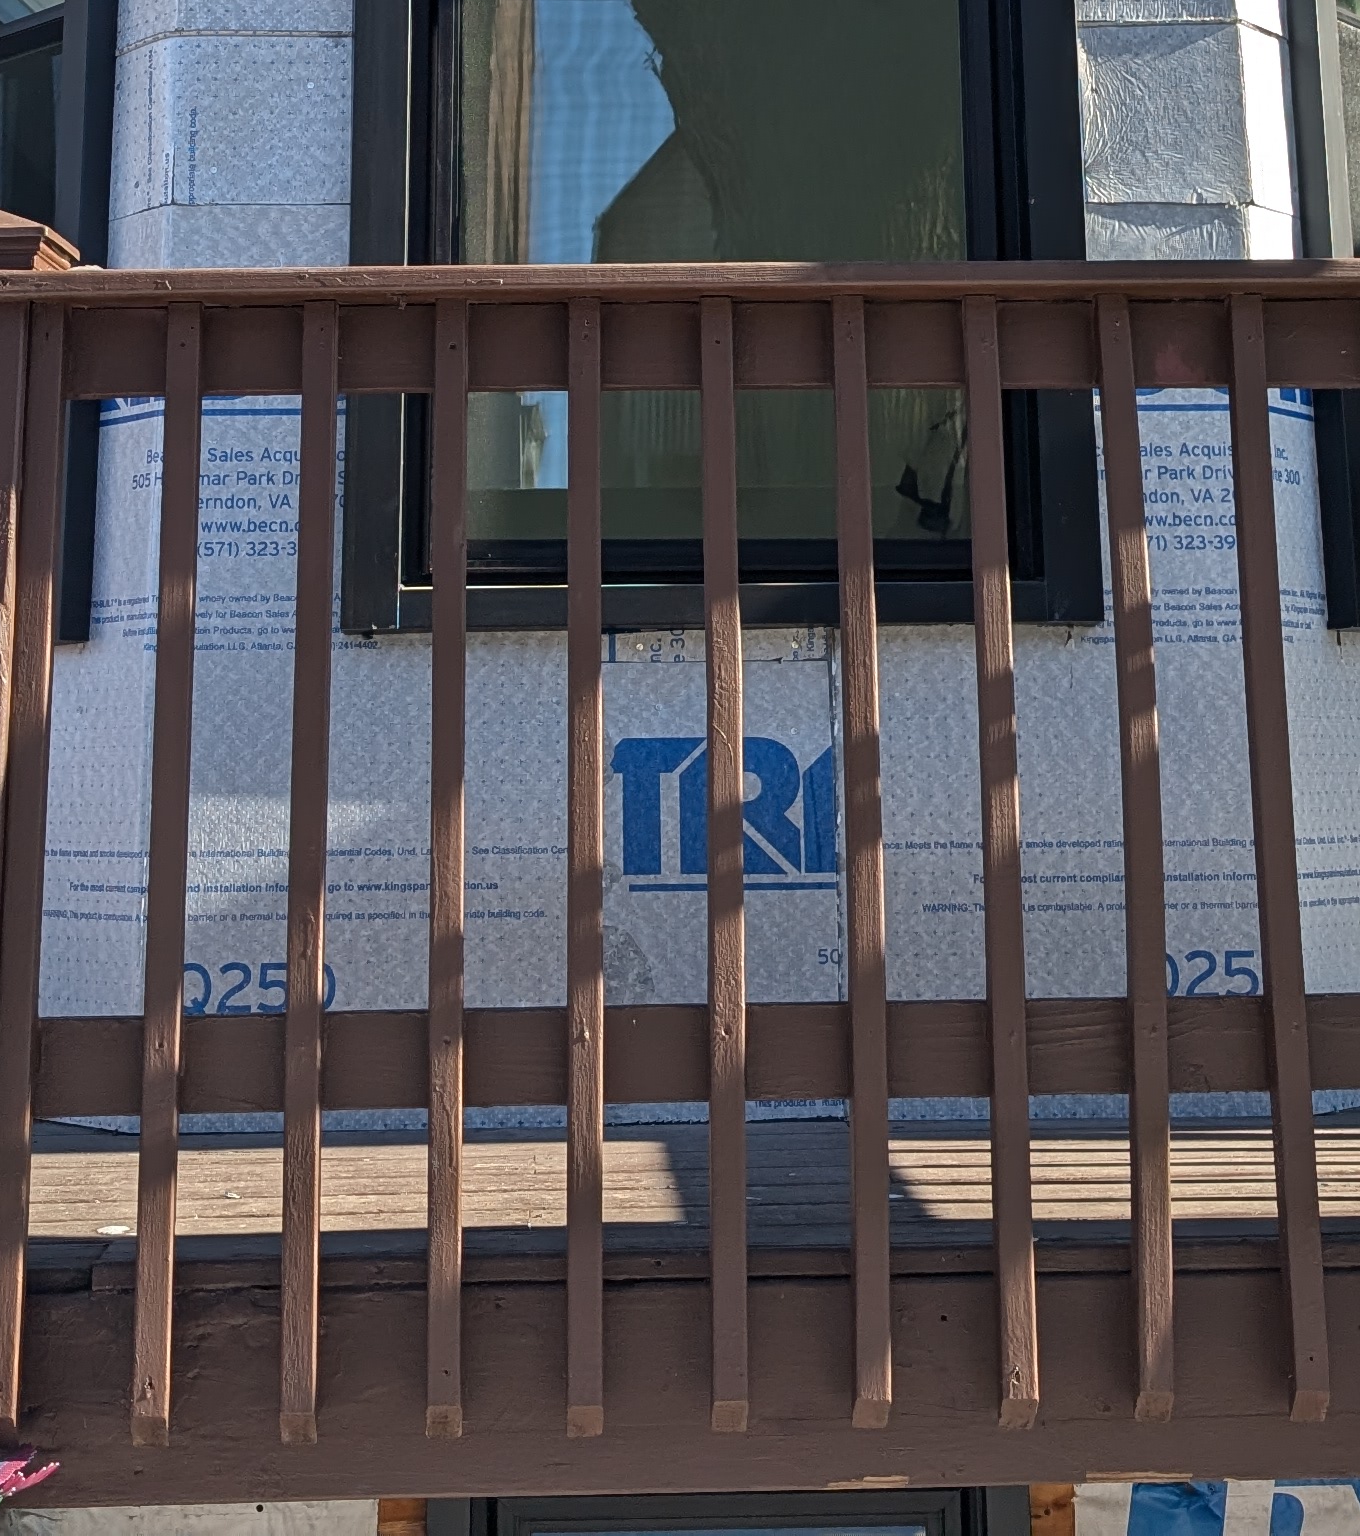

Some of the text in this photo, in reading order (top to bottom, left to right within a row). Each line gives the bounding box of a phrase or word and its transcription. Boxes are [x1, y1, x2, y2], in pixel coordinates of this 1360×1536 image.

[207, 447, 254, 463] Sales
[132, 472, 151, 490] 505
[236, 470, 275, 486] Park
[1157, 464, 1301, 486] Park 300
[268, 495, 291, 509] VA
[1191, 488, 1214, 503] VA
[197, 541, 239, 557] (571)
[1161, 587, 1238, 597] owned by Beacon
[228, 594, 257, 602] owned
[260, 594, 270, 604] by
[1164, 602, 1223, 612] Beacon Sales
[215, 610, 289, 618] for Beacon Sales
[1192, 618, 1214, 629] go to
[257, 627, 279, 637] go to
[1223, 634, 1236, 643] GA
[905, 837, 1246, 850] Meets the flame smoke developed Building
[364, 847, 395, 858] Codes,
[471, 846, 489, 855] See
[492, 845, 549, 855] Classification
[1040, 871, 1219, 884] current installation
[203, 883, 262, 893] installation
[328, 883, 342, 894] go
[344, 882, 354, 892] to
[1181, 901, 1190, 910] or
[1200, 900, 1233, 910] thermal
[187, 912, 217, 922] barrier
[239, 912, 273, 921] thermal
[355, 913, 365, 921] as
[367, 912, 405, 923] specified
[408, 911, 416, 920] in
[487, 909, 520, 920] building
[523, 910, 547, 919] code.
